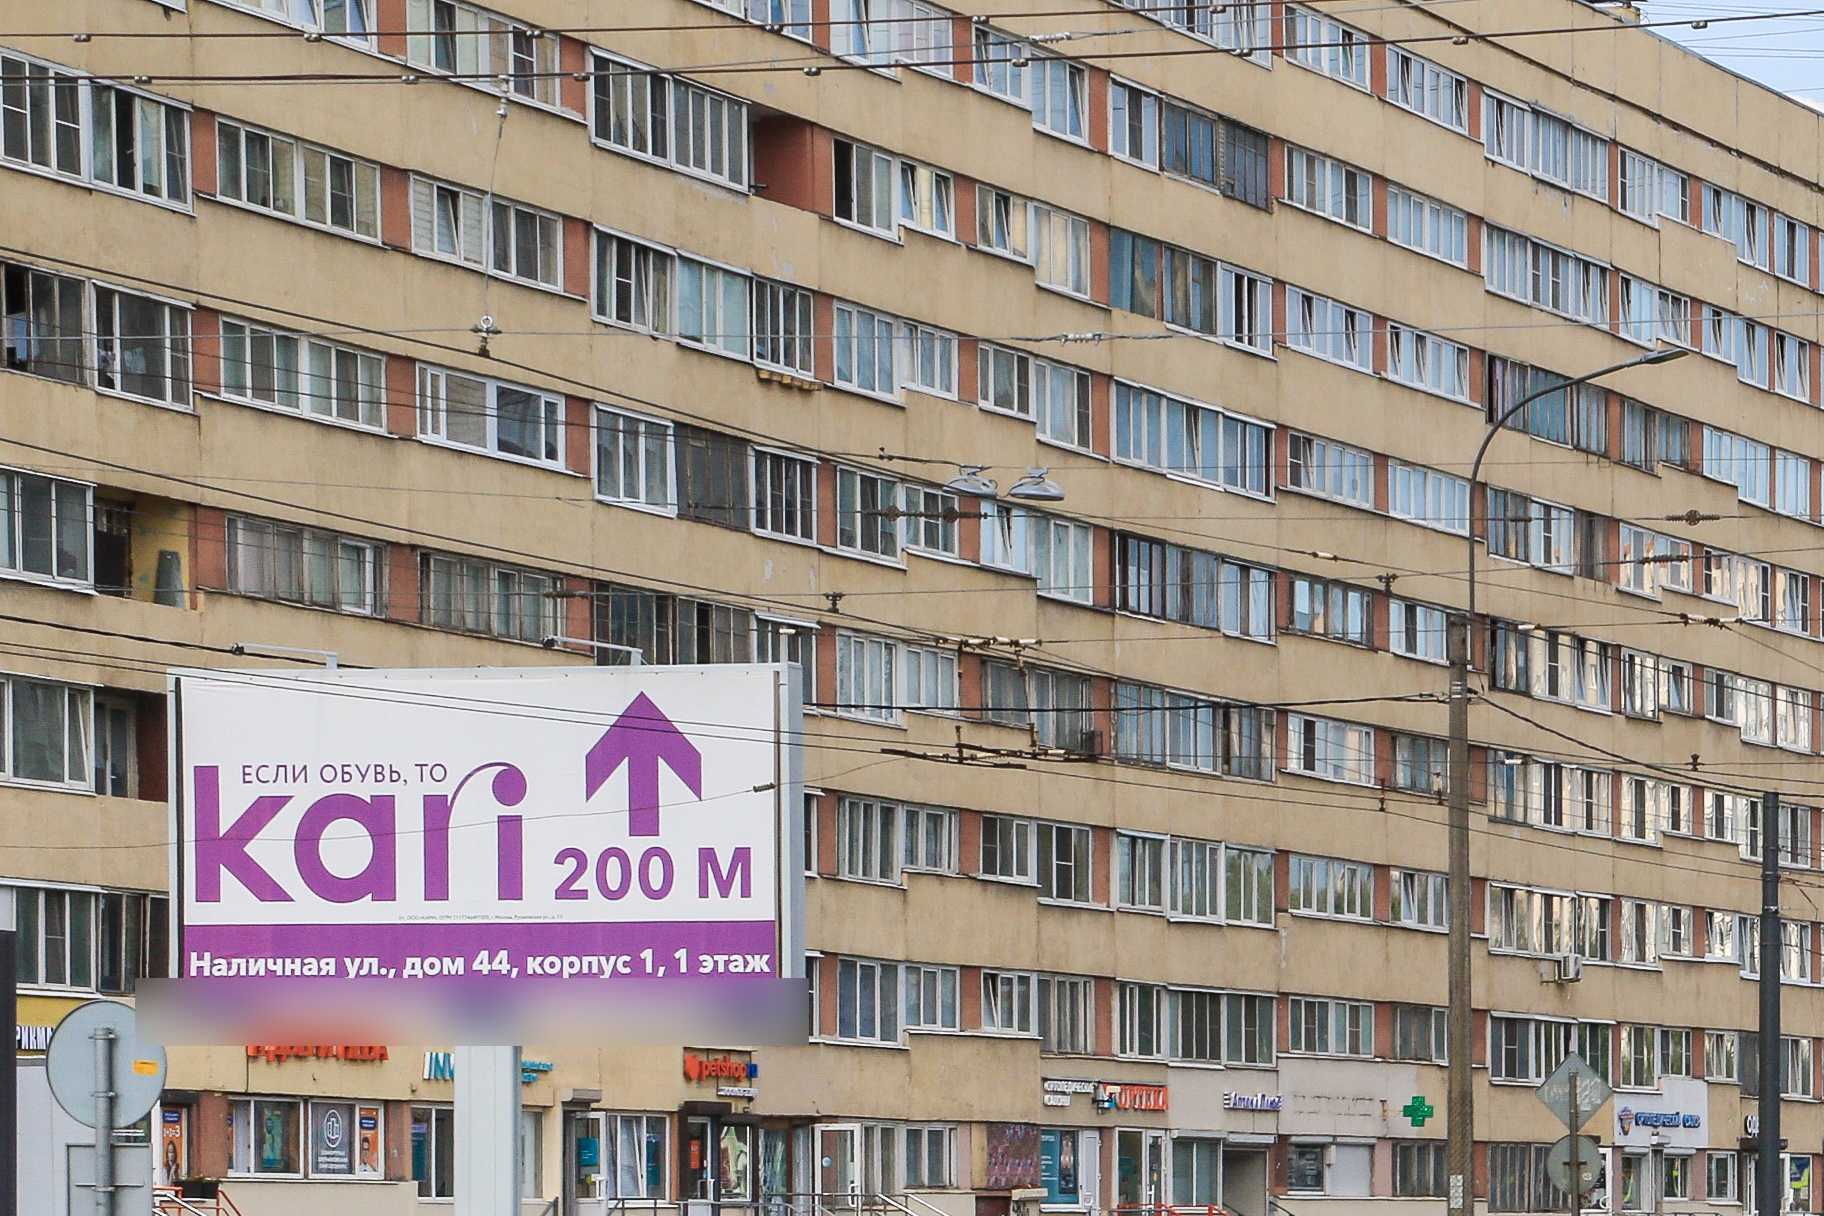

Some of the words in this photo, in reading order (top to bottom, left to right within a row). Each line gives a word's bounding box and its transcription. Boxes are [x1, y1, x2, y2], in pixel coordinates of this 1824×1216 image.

[242, 763, 308, 784] ЕСЛИ
[320, 763, 409, 786] ОБУВЬ,
[414, 763, 448, 783] ТО
[194, 761, 527, 904] kari
[554, 847, 674, 901] 200
[698, 847, 752, 899] М
[189, 952, 336, 978] Наличная
[344, 957, 397, 979] ул.,
[403, 957, 465, 979] дом
[472, 949, 520, 979] 44,
[527, 953, 632, 979] корпус
[640, 948, 666, 978] 1,
[674, 948, 689, 974] 1
[698, 953, 770, 974] этаж
